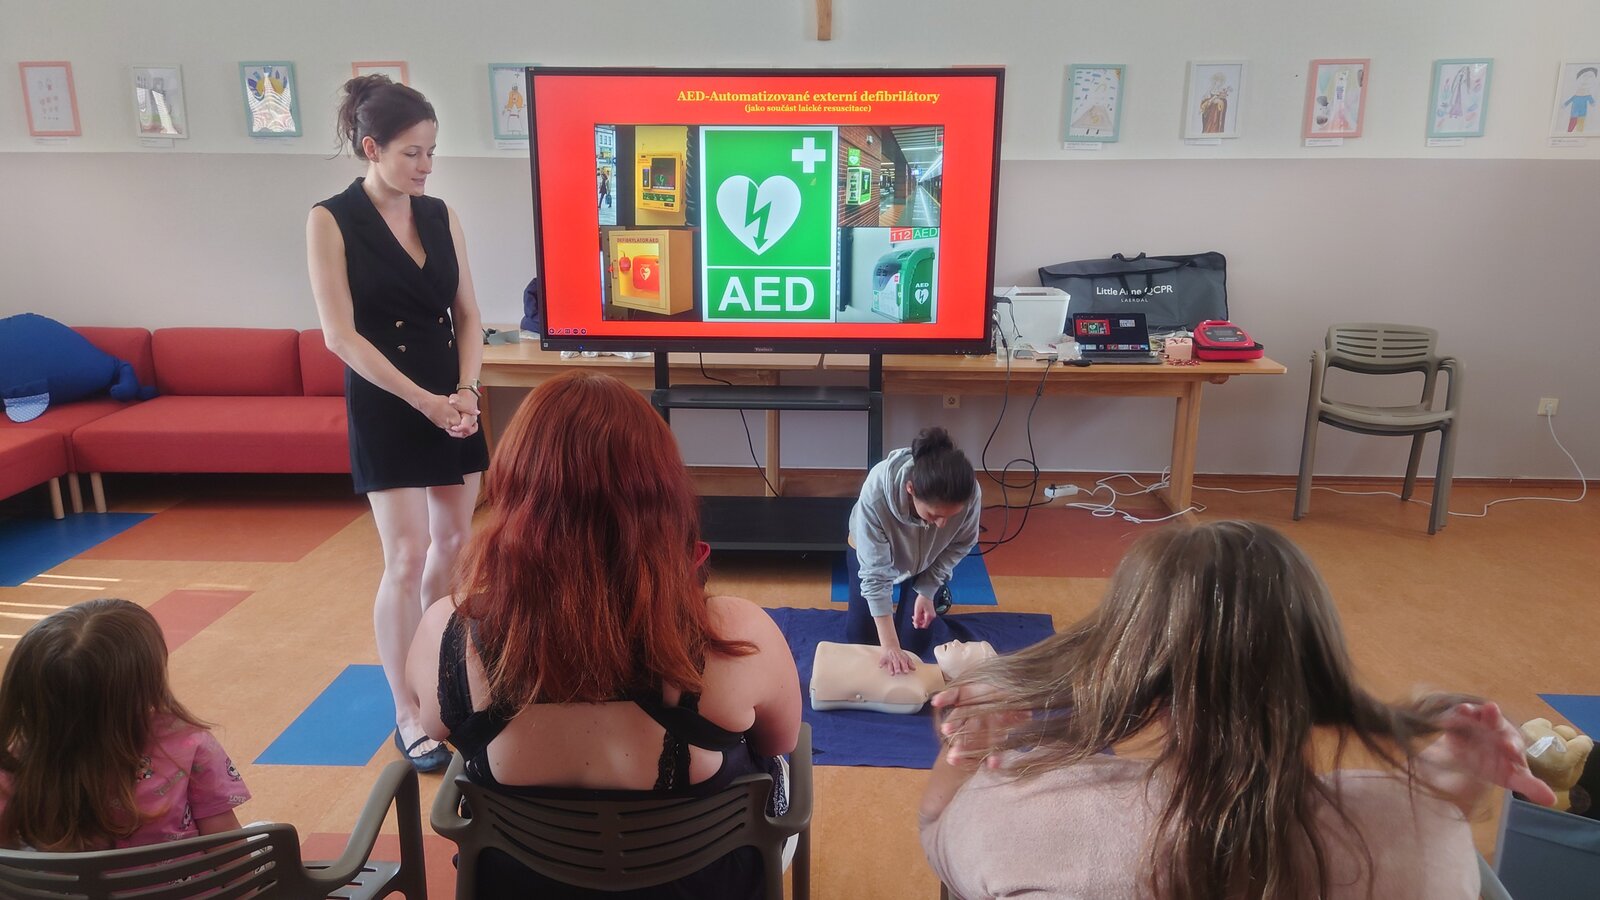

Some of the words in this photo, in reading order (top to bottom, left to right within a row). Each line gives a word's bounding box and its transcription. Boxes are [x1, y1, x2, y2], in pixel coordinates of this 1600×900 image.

[677, 91, 810, 102] AED-Automatizované
[813, 90, 858, 102] externí
[860, 90, 940, 104] defibrilátory
[744, 104, 766, 113] (jako
[767, 104, 797, 112] součást
[799, 104, 822, 112] laické
[823, 104, 872, 113] resuscitace)
[891, 230, 911, 241] 112
[913, 227, 938, 239] AED
[717, 276, 815, 312] AED
[1096, 286, 1118, 296] Little
